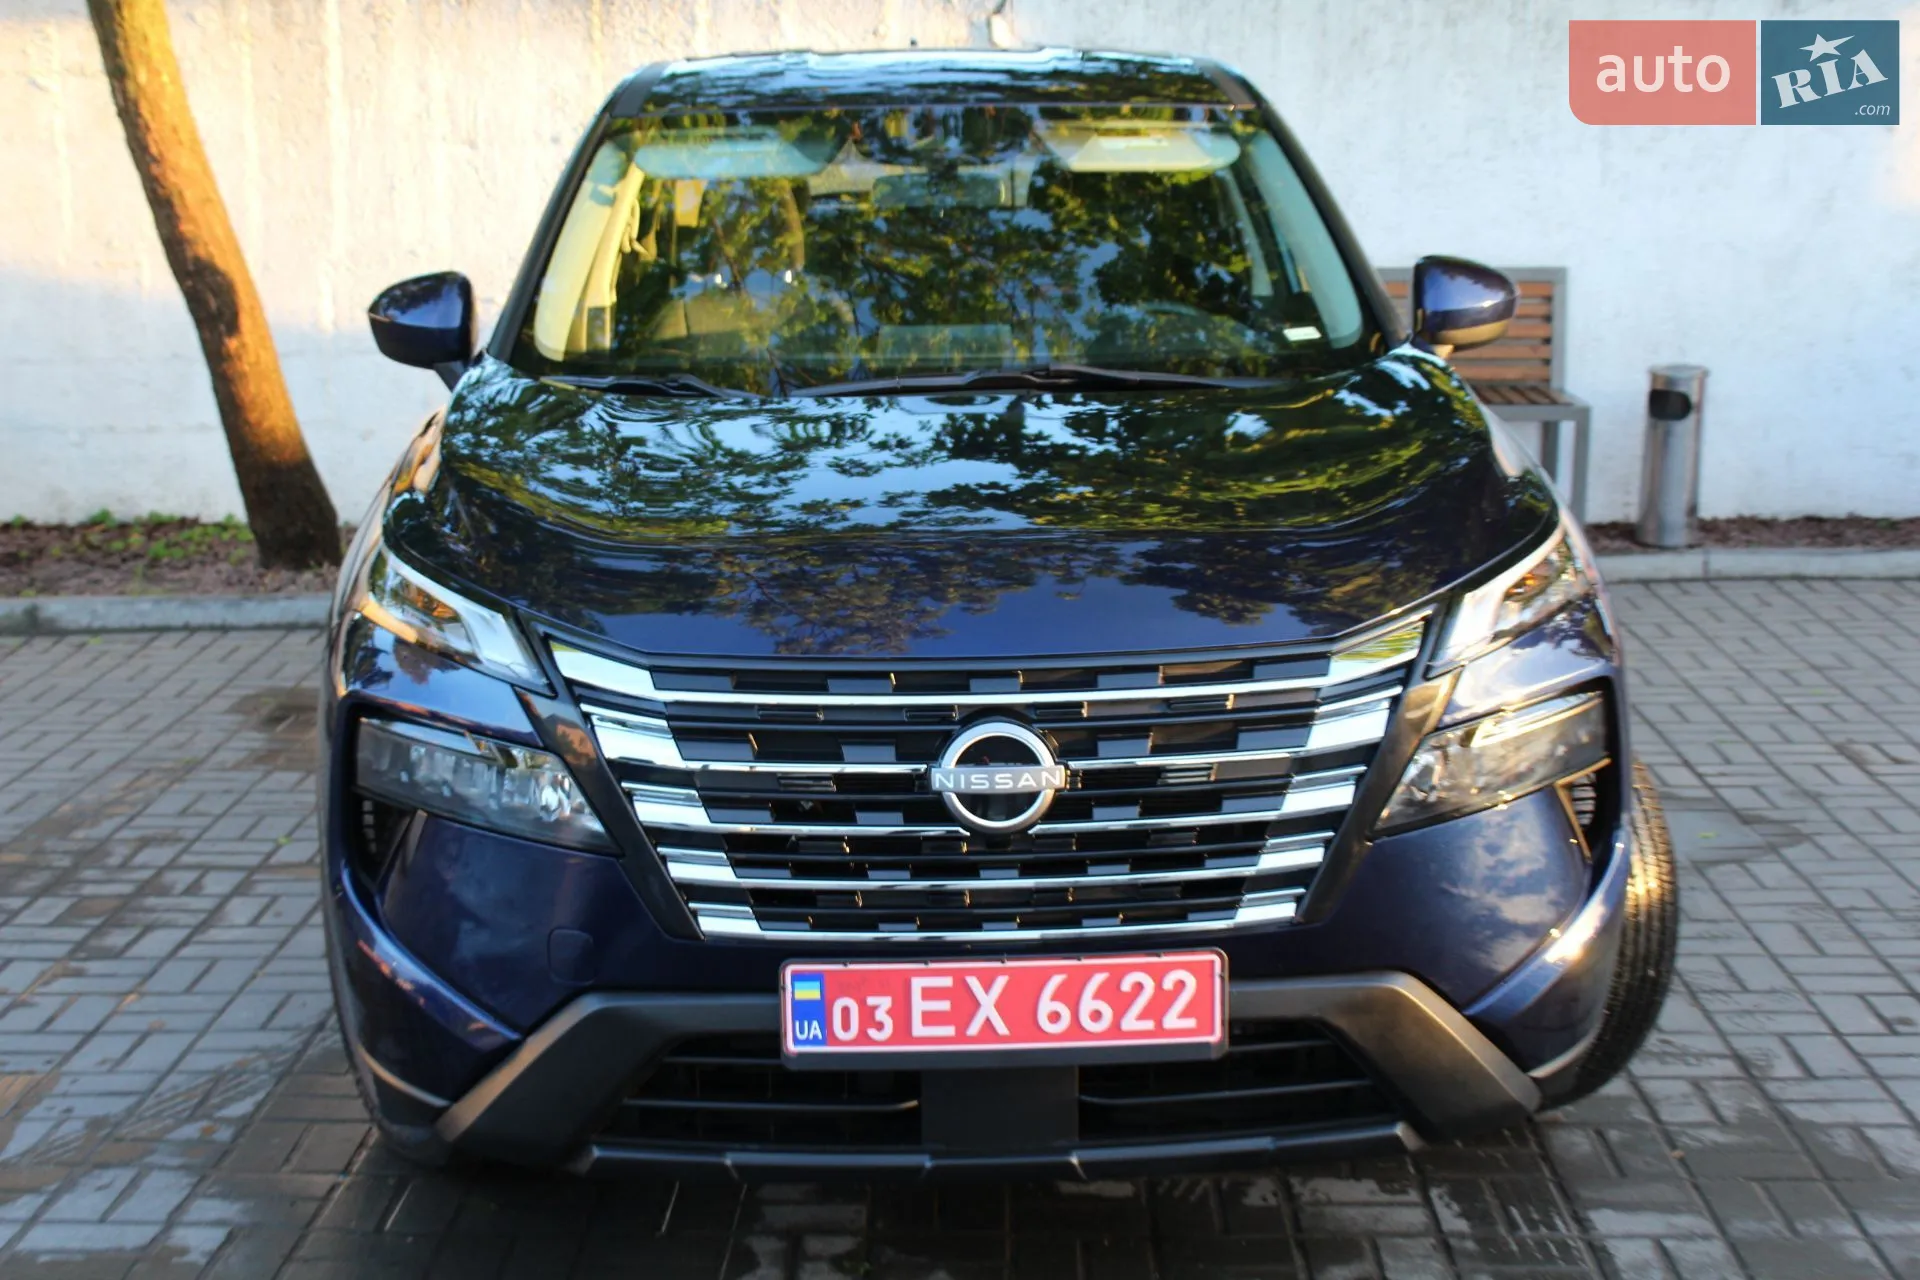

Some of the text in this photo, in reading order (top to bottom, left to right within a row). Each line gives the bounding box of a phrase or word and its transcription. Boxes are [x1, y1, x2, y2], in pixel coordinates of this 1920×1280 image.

[934, 769, 1060, 790] NISSAN
[832, 969, 1197, 1041] 03 EX 6622
[795, 1019, 823, 1040] UA
